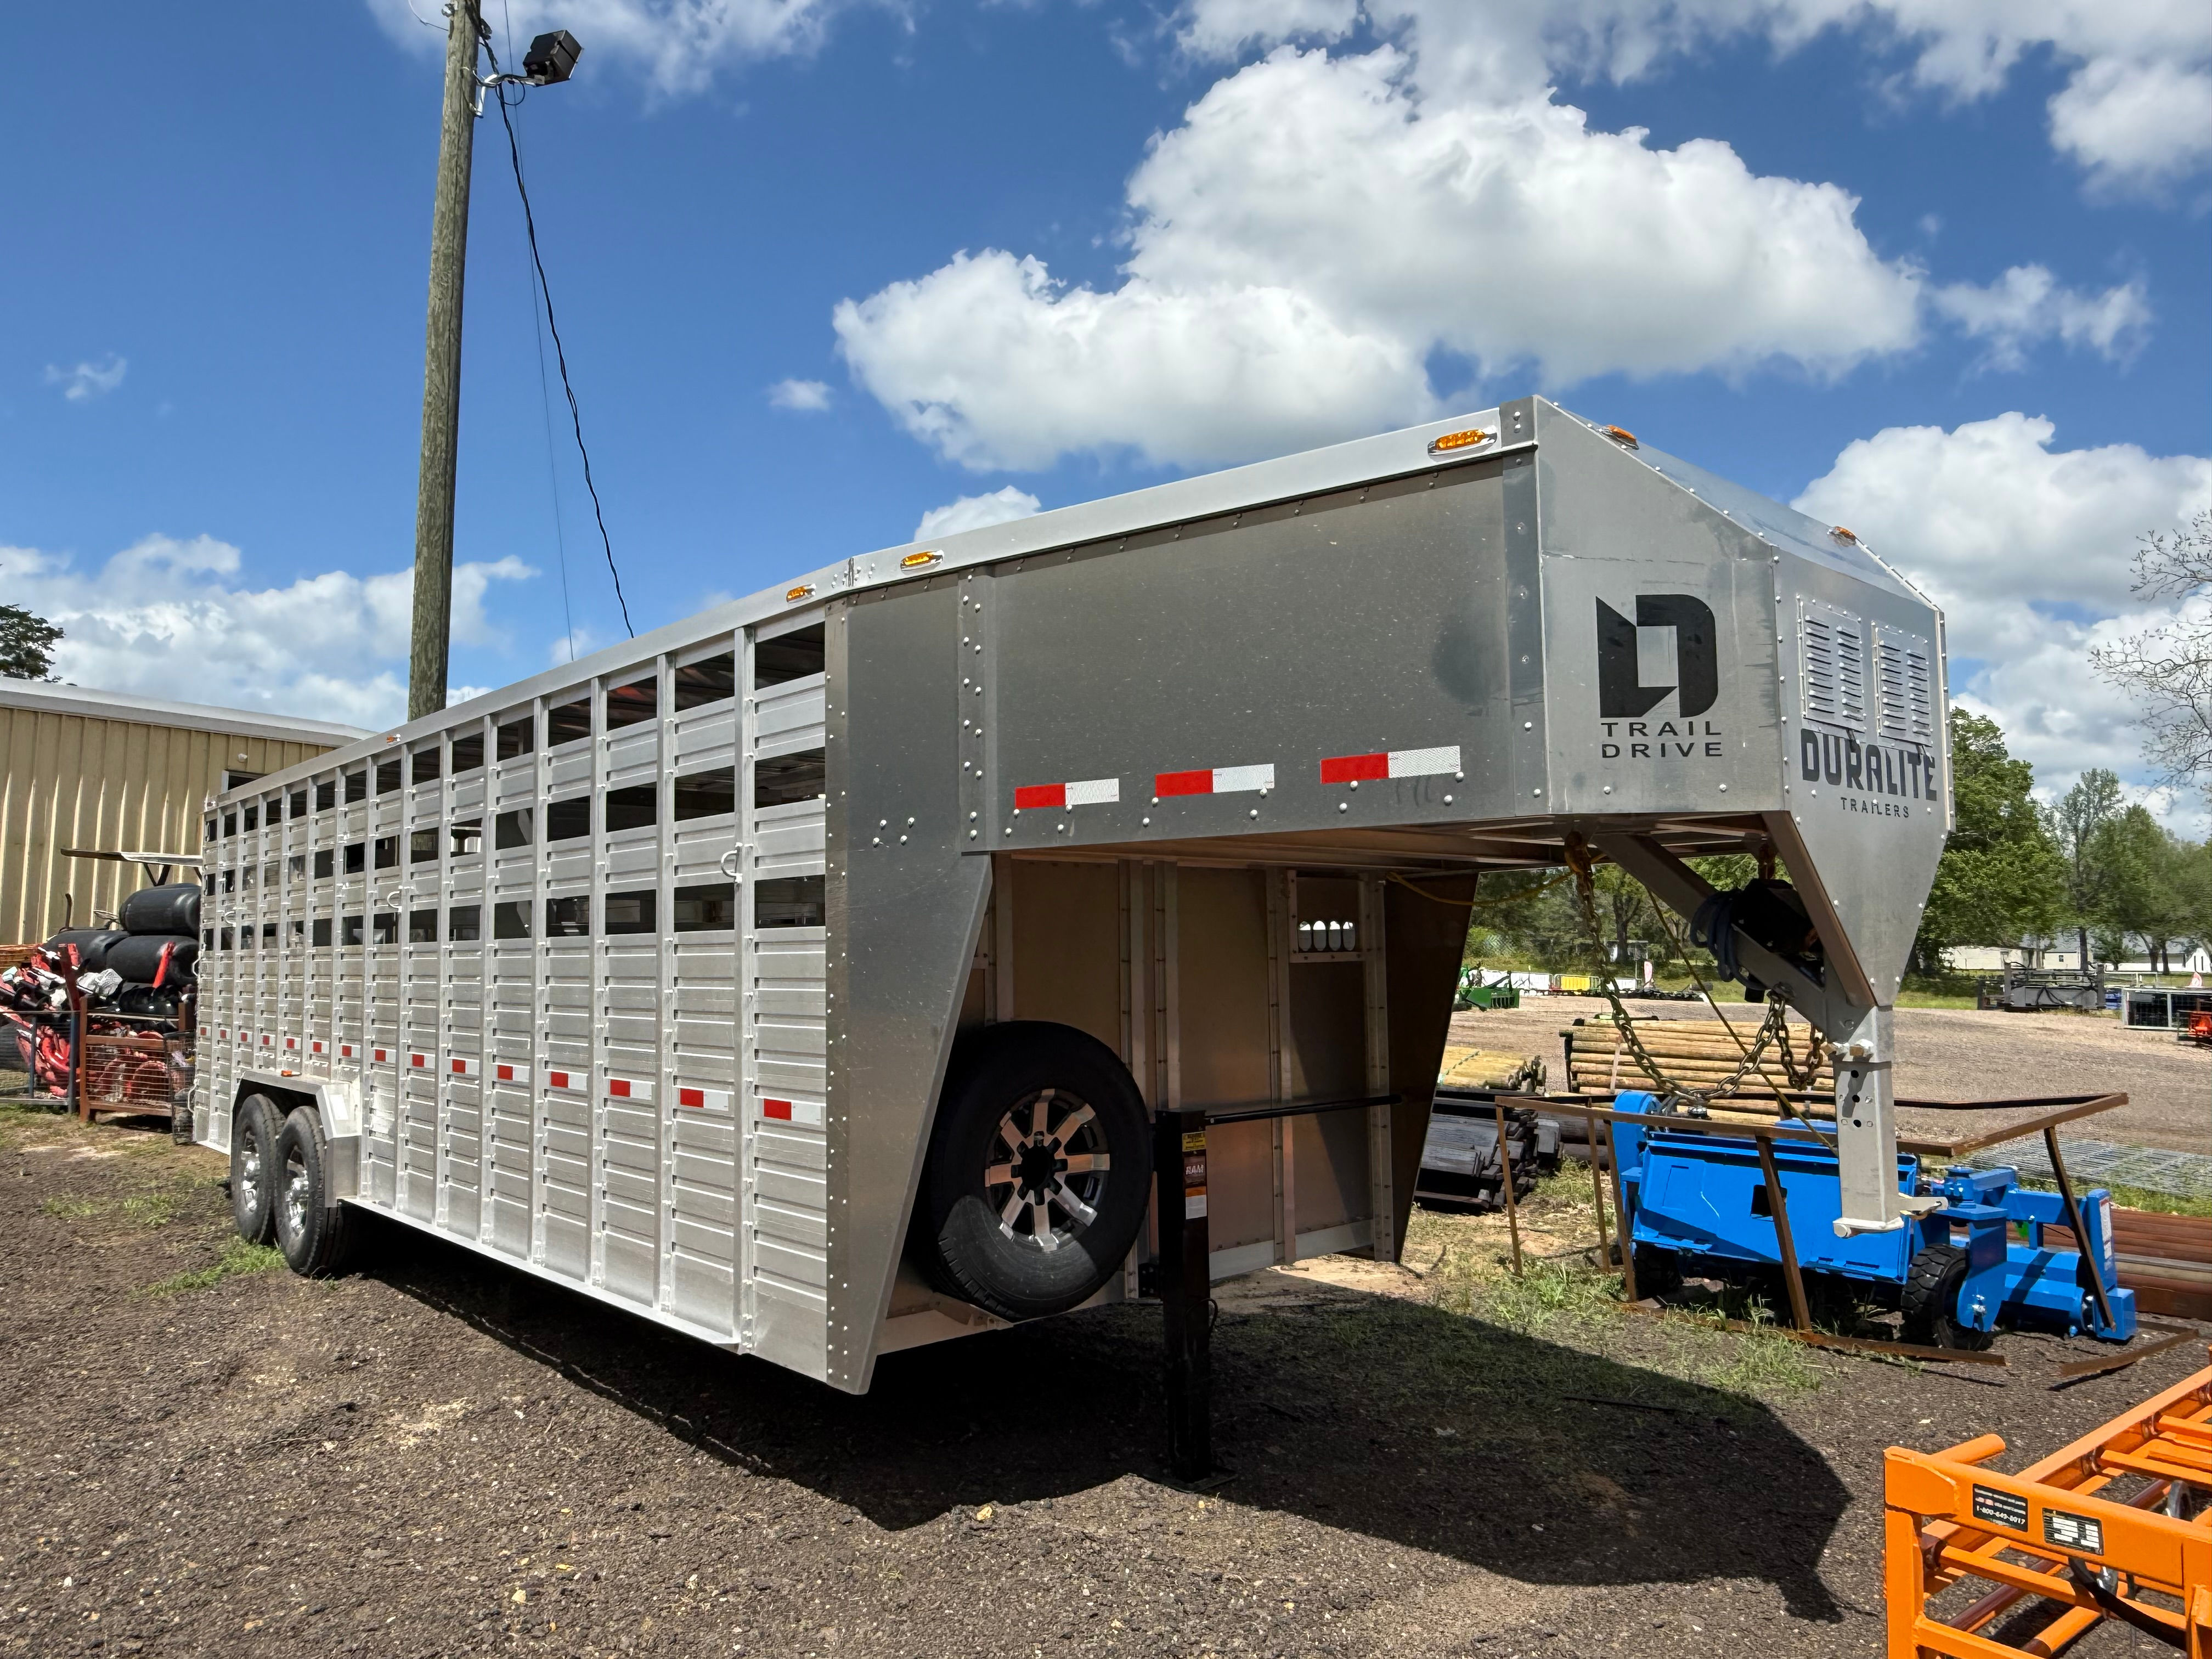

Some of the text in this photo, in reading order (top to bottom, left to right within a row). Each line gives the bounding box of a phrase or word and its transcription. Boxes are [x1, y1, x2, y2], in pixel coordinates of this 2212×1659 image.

[1600, 720, 1722, 737] TRAIL
[1601, 742, 1723, 758] DRIVE
[1801, 727, 1937, 802] DURALITE
[1840, 797, 1910, 819] TRAILERS
